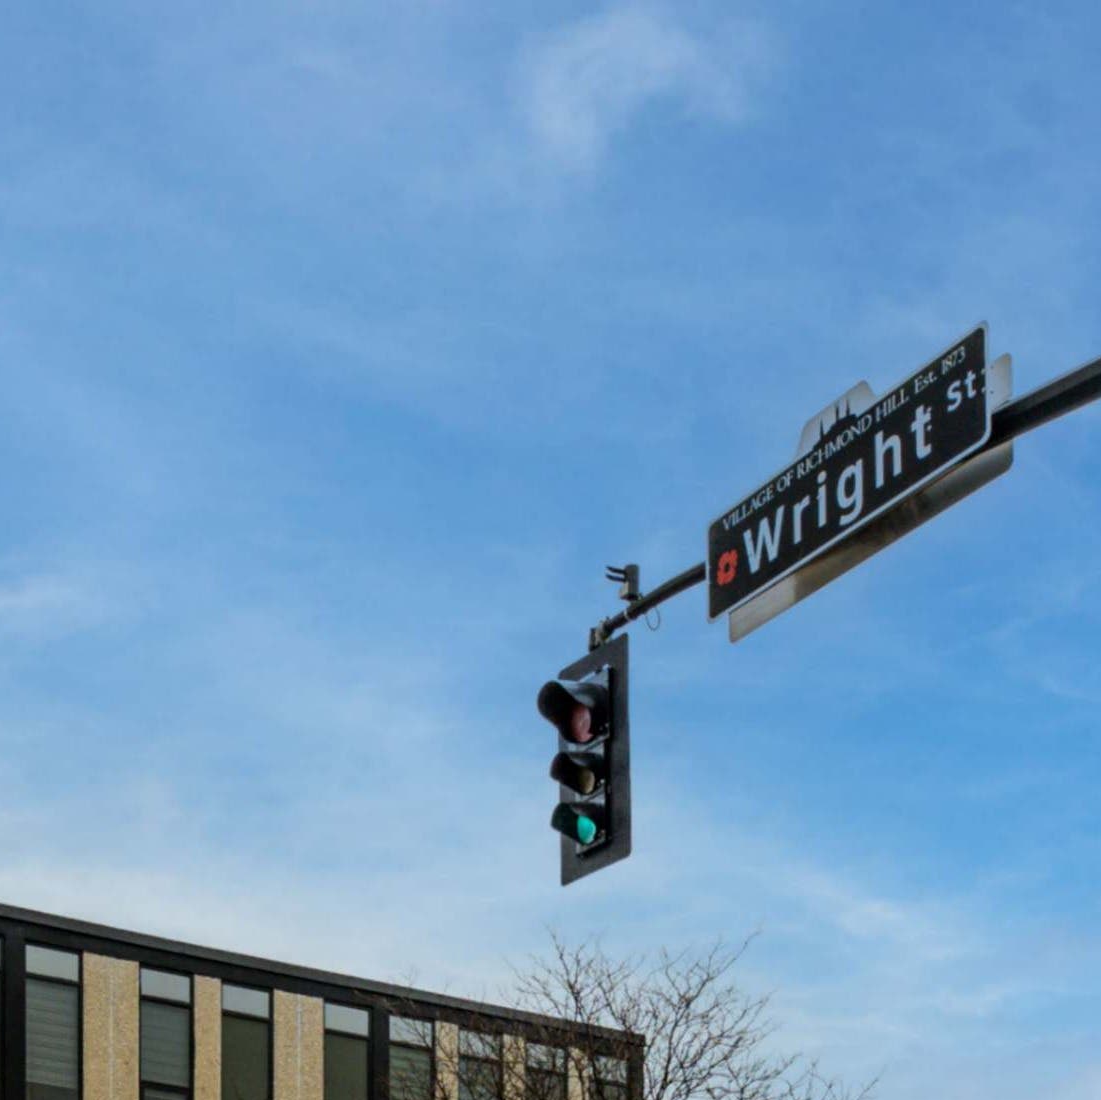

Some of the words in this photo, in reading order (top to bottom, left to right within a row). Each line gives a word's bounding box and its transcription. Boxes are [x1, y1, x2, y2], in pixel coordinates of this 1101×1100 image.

[722, 483, 776, 531] VILLAGE
[776, 470, 796, 493] OF
[796, 413, 874, 480] RICHMOND
[875, 389, 909, 424] HILL
[913, 370, 938, 395] Est.
[940, 346, 967, 376] 1873
[743, 404, 933, 575] Wright
[946, 369, 977, 412] St
